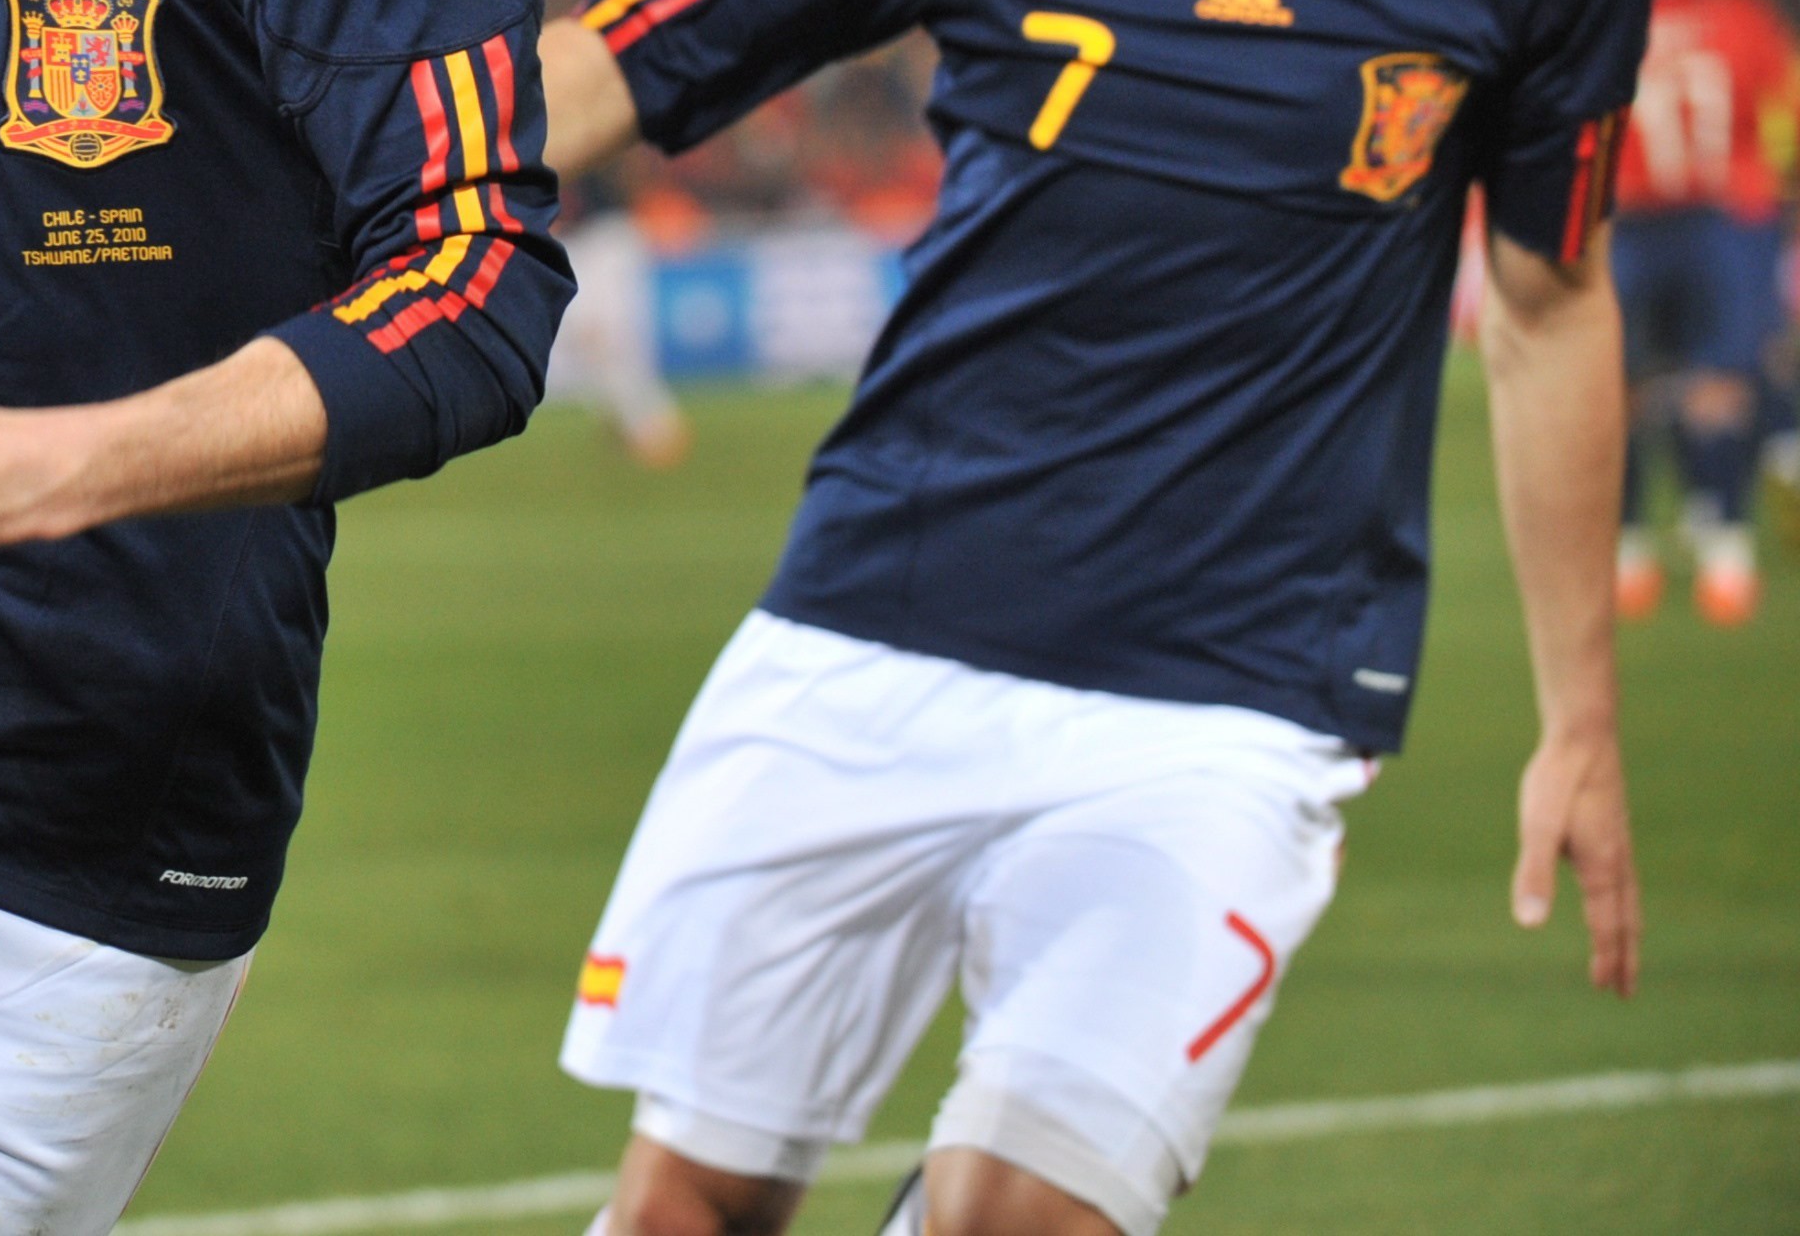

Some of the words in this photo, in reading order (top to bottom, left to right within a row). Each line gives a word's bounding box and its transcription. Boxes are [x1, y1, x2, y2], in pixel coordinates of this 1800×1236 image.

[1021, 10, 1116, 151] 7
[42, 210, 85, 227] CHILE
[99, 208, 143, 224] SPAIN
[43, 230, 82, 247] JUNE
[85, 228, 109, 245] 25,
[112, 227, 147, 243] 2010
[22, 245, 173, 266] TSHWANE/PRETORIA
[159, 869, 248, 889] FORMOTION
[1184, 909, 1277, 1065] 7
